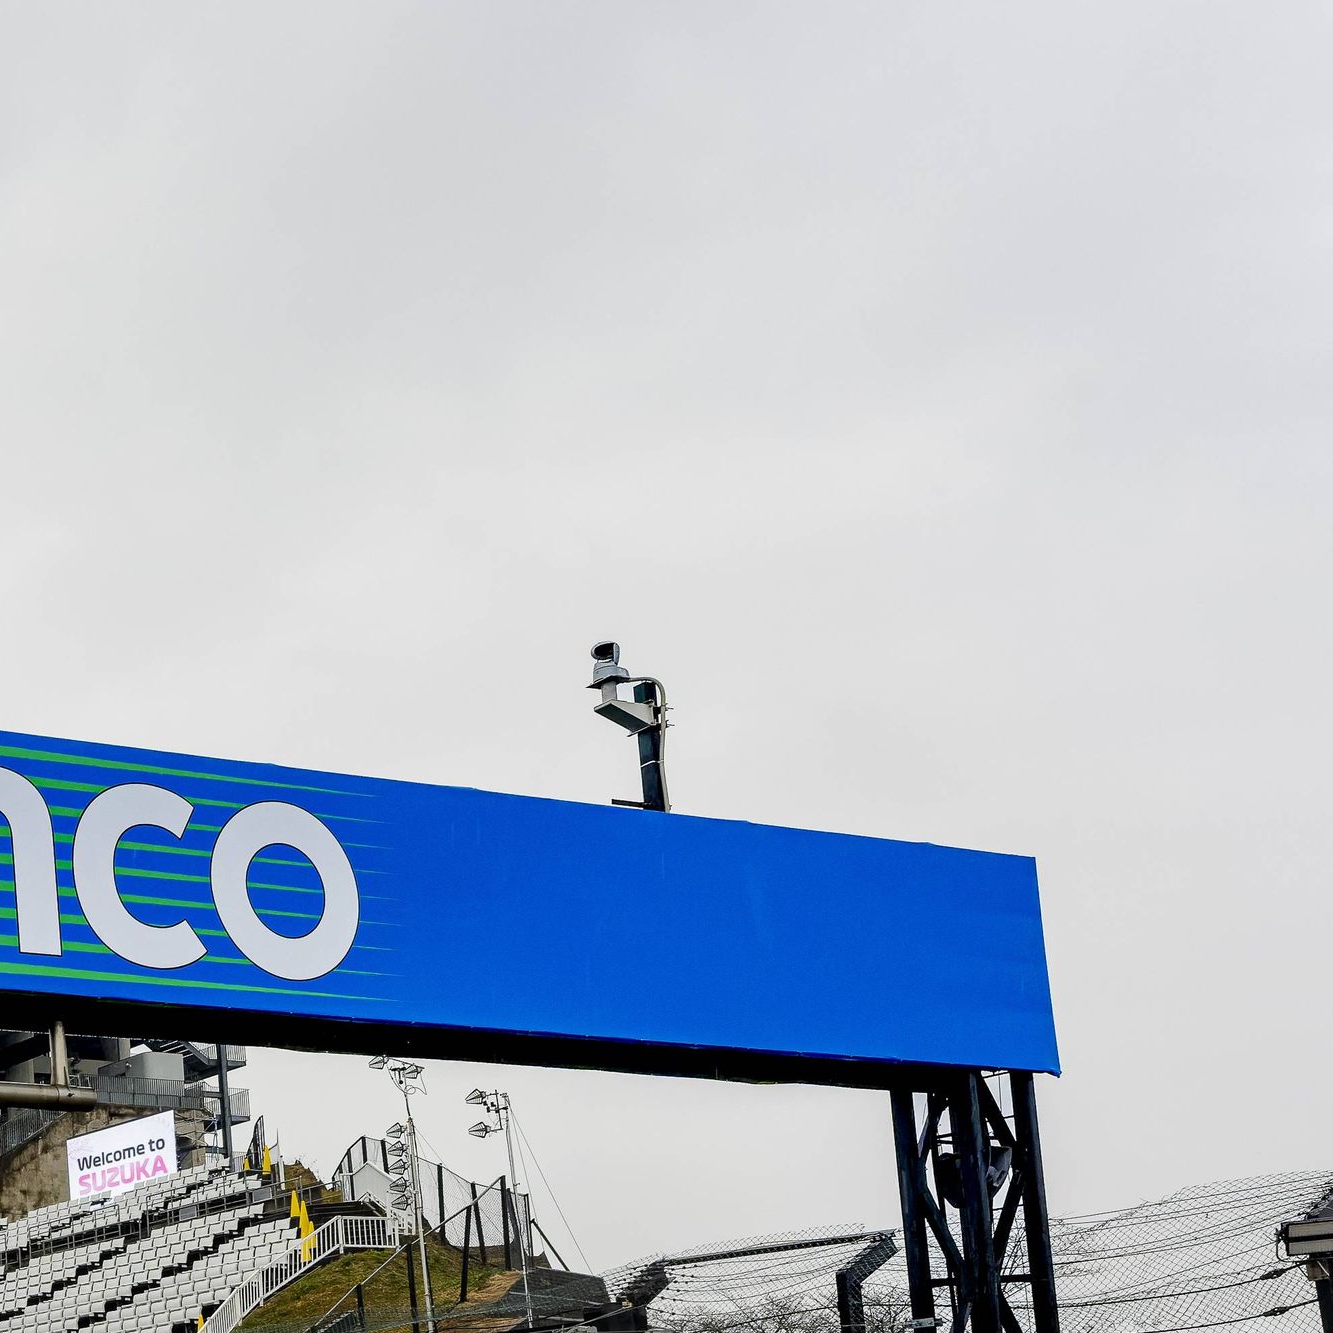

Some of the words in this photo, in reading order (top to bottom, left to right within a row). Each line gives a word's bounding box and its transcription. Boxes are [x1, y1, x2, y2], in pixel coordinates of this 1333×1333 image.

[77, 1143, 145, 1172] Welcome
[148, 1138, 165, 1152] to
[78, 1155, 168, 1196] SUZUKA
